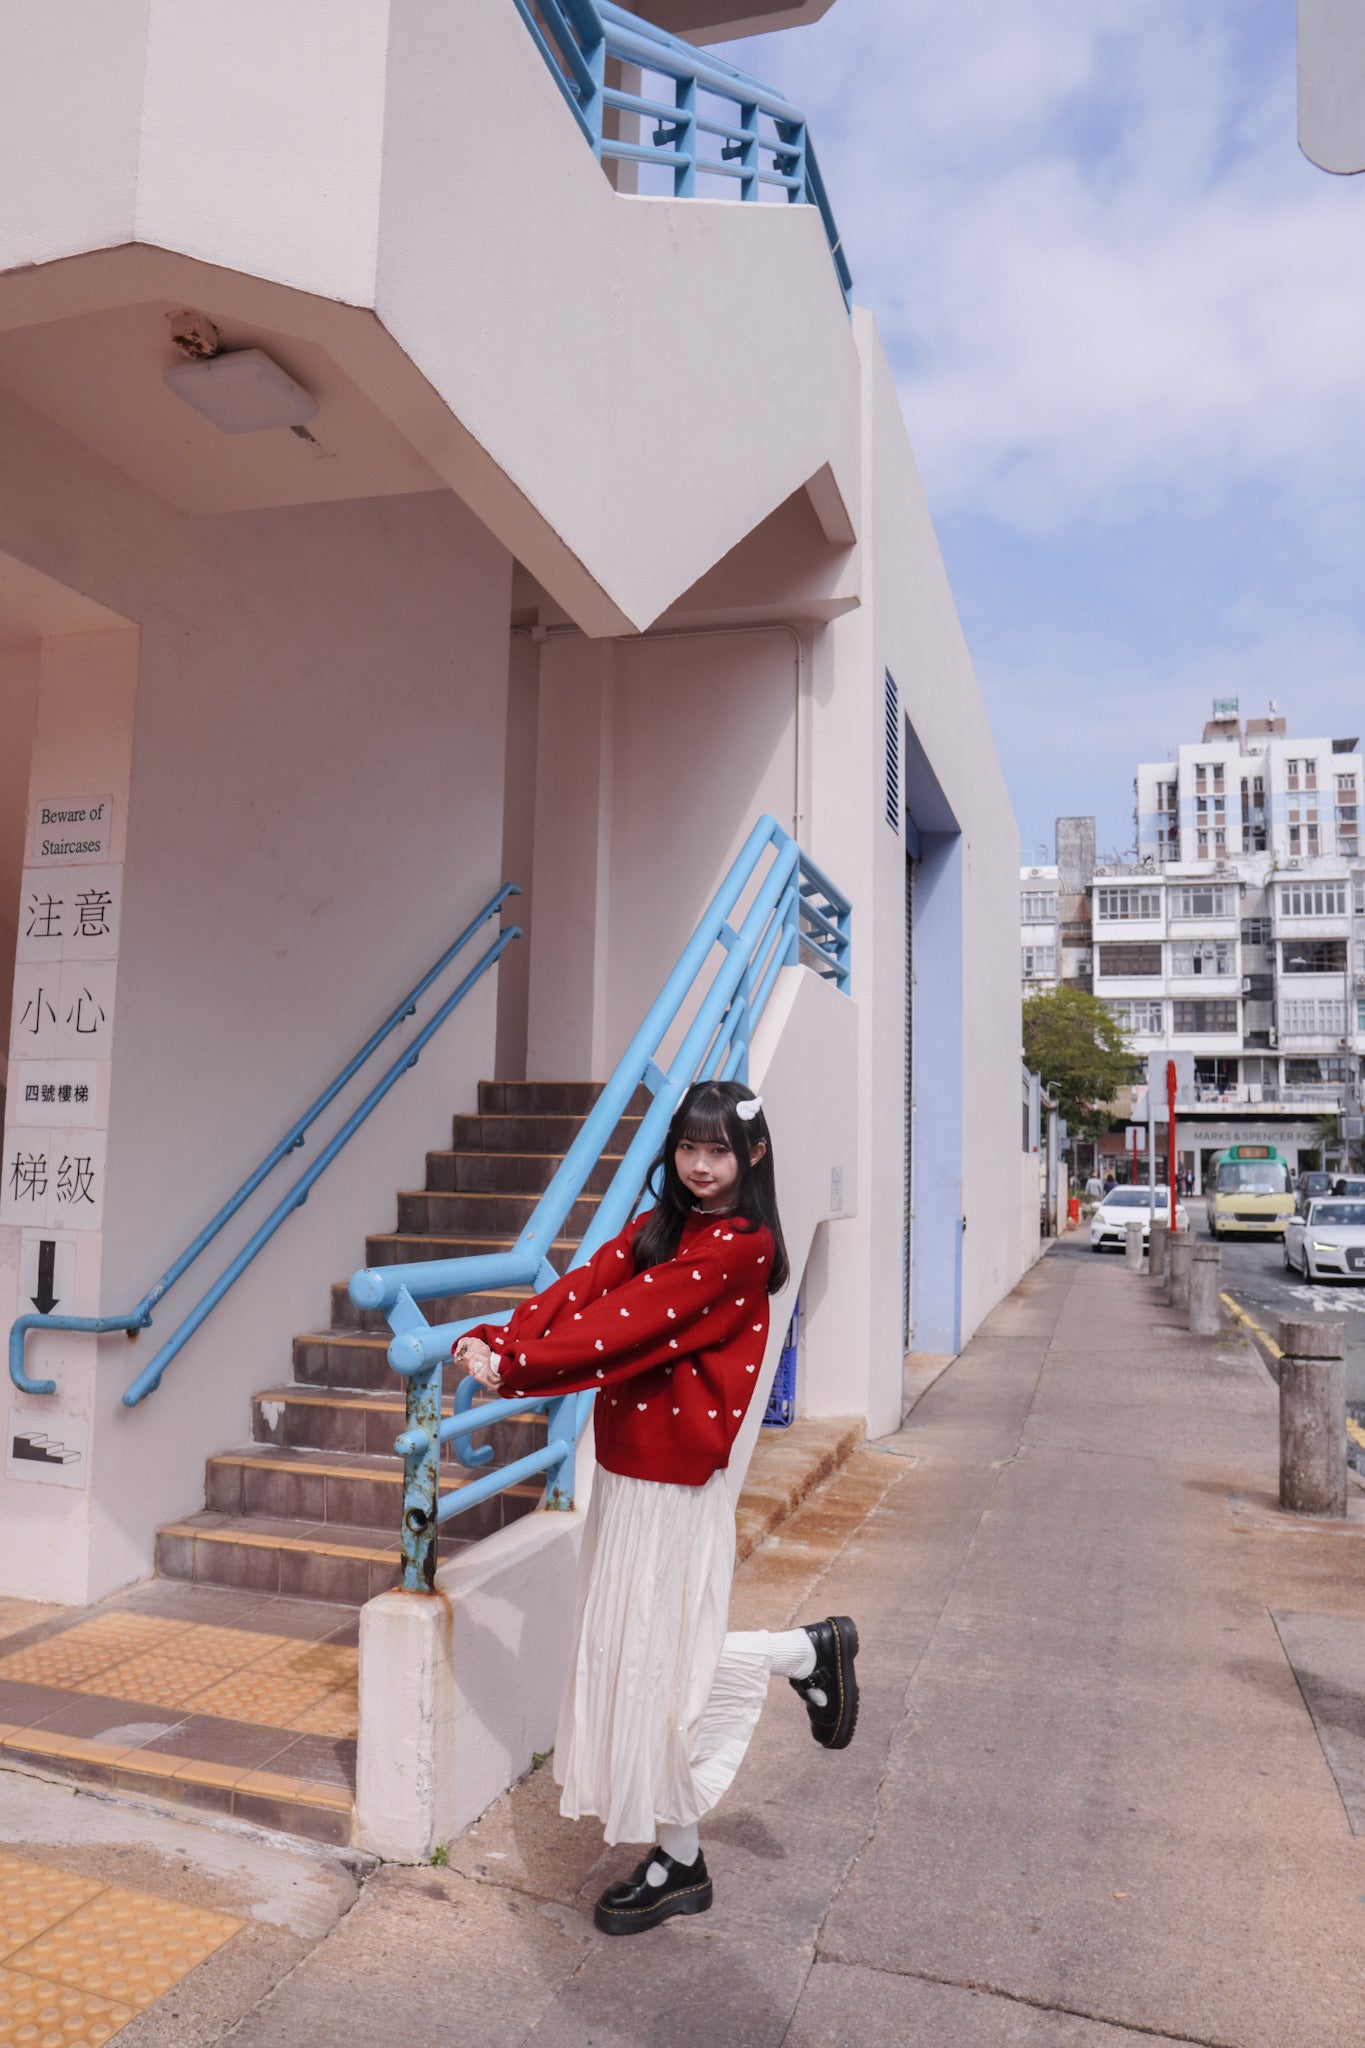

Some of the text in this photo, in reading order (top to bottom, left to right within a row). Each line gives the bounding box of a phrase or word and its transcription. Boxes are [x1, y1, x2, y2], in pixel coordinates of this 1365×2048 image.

[41, 804, 104, 824] Beware of
[41, 839, 101, 856] Staircases
[26, 888, 112, 937] 注意
[19, 986, 105, 1034] 小心
[25, 1084, 89, 1103] 四號樓梯
[1193, 1131, 1232, 1142] MARKS
[1233, 1131, 1241, 1142] &
[1242, 1131, 1294, 1143] SPENCER
[9, 1152, 96, 1204] 梯級
